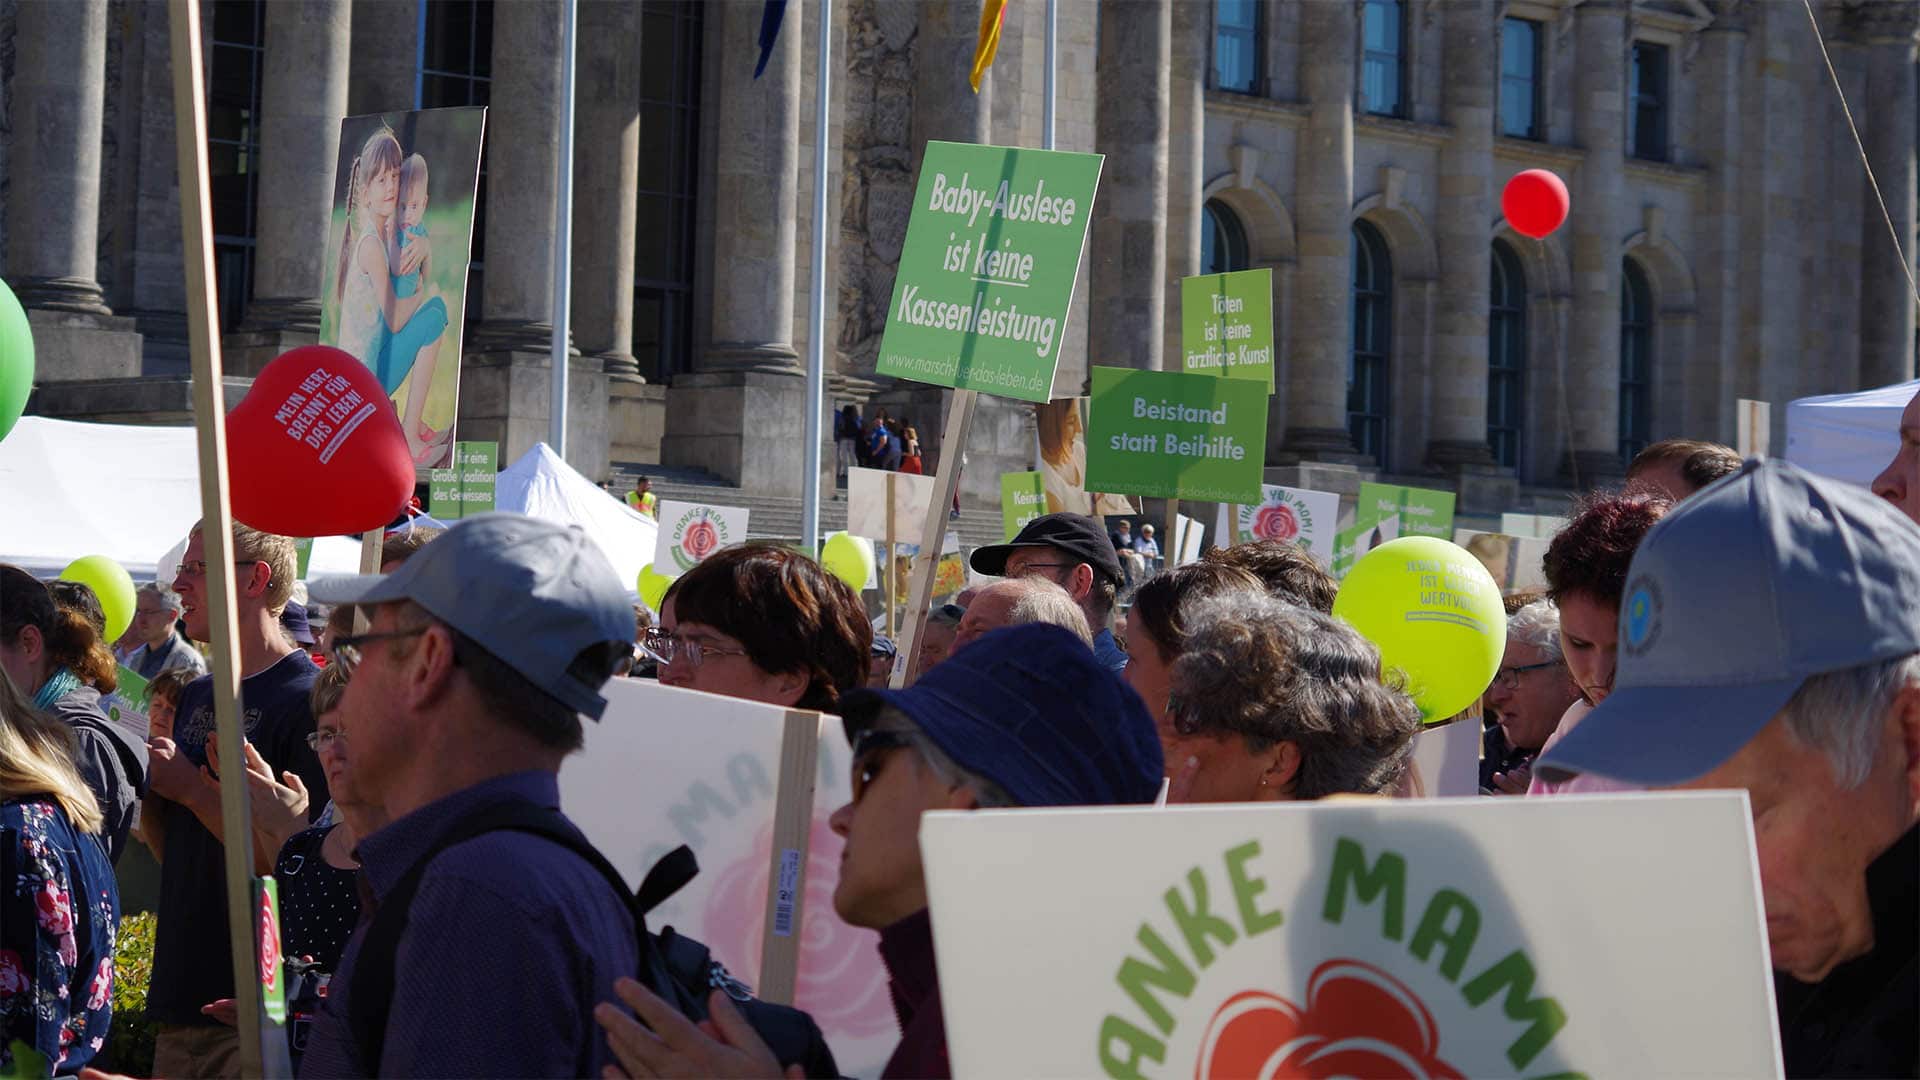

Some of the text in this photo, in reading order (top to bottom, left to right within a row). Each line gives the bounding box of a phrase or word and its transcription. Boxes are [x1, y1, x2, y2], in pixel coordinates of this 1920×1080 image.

[929, 172, 1076, 227] Baby-Auslese
[943, 232, 1034, 283] ist keine
[1211, 293, 1243, 314] Töten
[897, 284, 1057, 358] Kassenleistung
[1204, 318, 1252, 341] ist keine
[1187, 345, 1270, 369] ärztliche Kunst
[886, 352, 1044, 392] www.marsch-fuer-das-leben.de
[274, 367, 332, 425] MEIN HERZ
[286, 391, 331, 441] BRENNT
[324, 374, 352, 396] FÜR
[305, 420, 333, 449] DAS
[325, 388, 364, 425] LEBEN!
[1133, 397, 1227, 425] Beistand
[470, 450, 489, 464] eine
[1110, 432, 1246, 461] statt Beihilfe
[431, 469, 457, 483] Große
[433, 487, 492, 502] des Gewissens
[1269, 489, 1294, 502] YOU
[672, 507, 701, 540] DANKE
[1420, 575, 1438, 588] IST
[1323, 837, 1592, 1080] MAM
